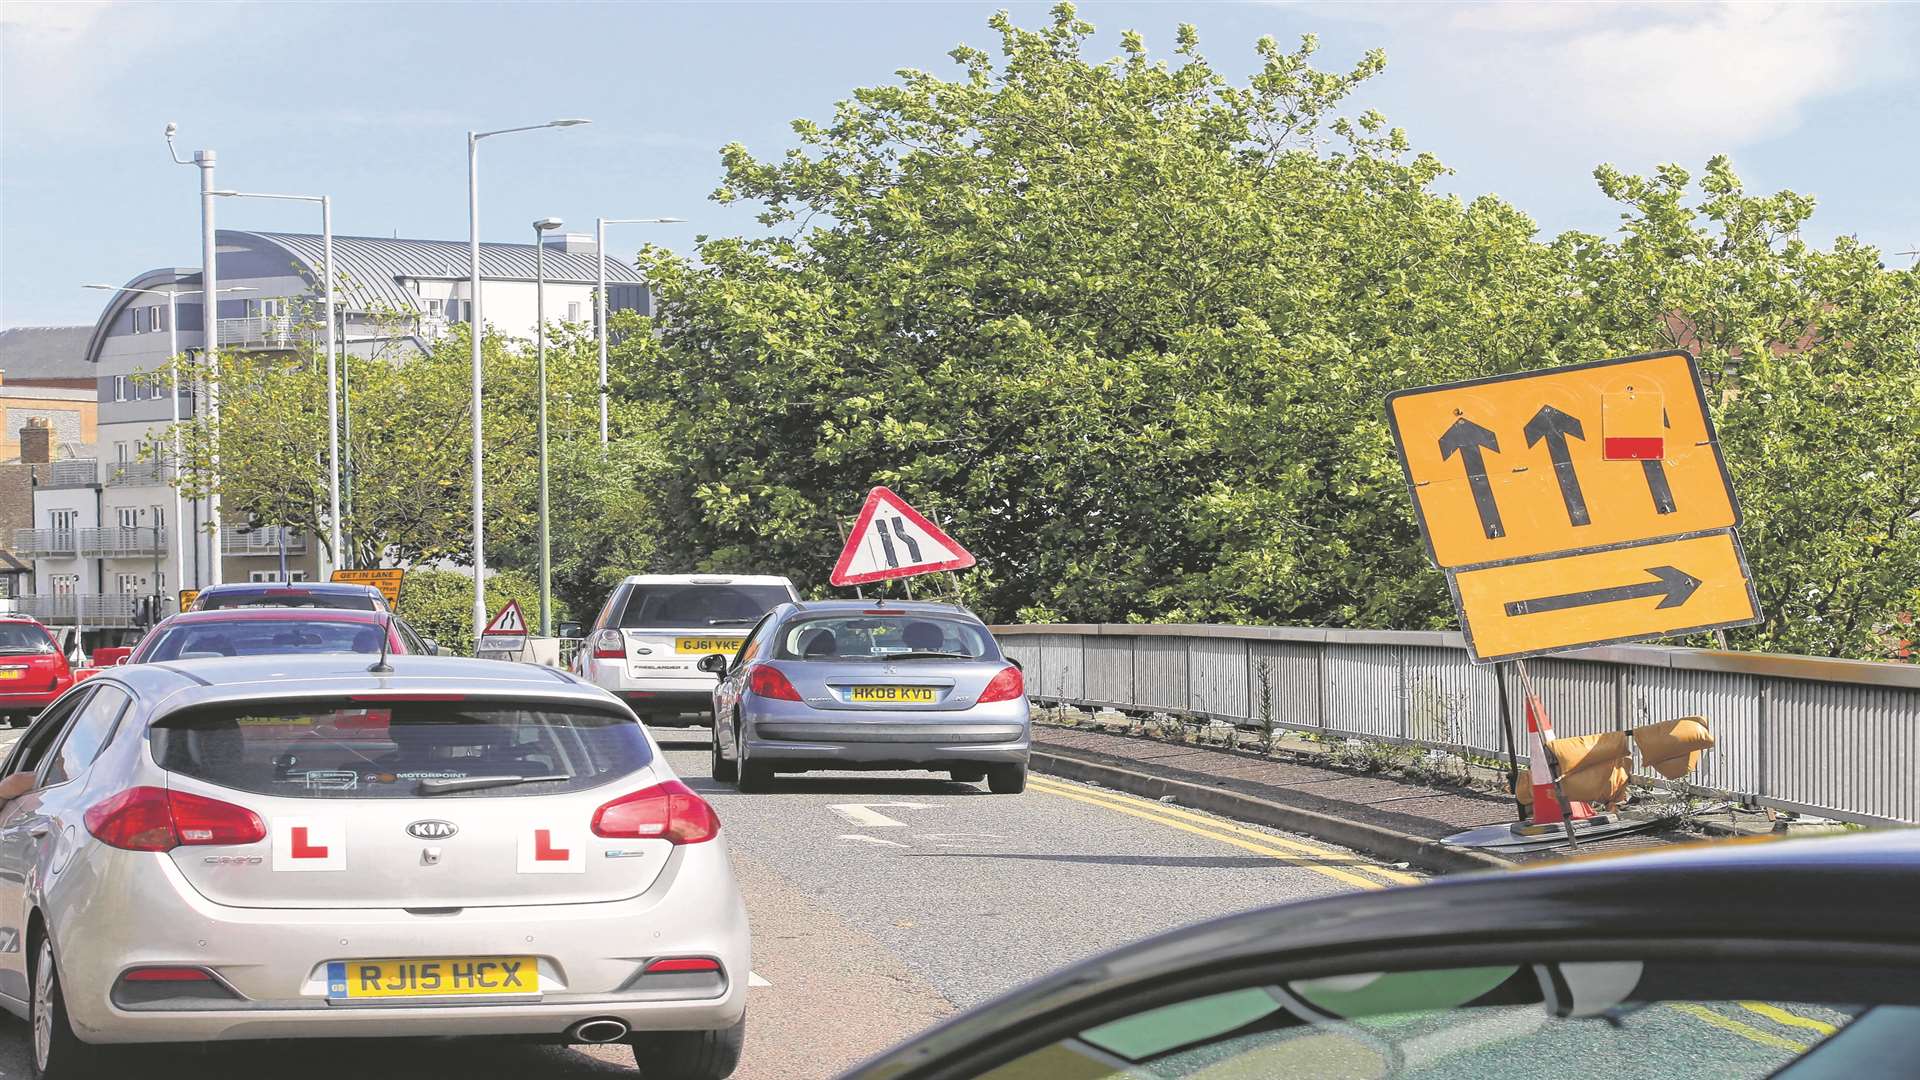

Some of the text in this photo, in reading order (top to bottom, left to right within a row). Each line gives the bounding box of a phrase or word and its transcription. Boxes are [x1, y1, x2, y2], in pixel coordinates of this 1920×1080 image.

[683, 640, 740, 650] GJ61 YKE
[854, 688, 932, 699] HK08 KVD
[414, 822, 450, 835] KIA
[291, 827, 328, 858] L
[535, 829, 569, 861] L
[360, 962, 523, 991] RJ15 HCX
